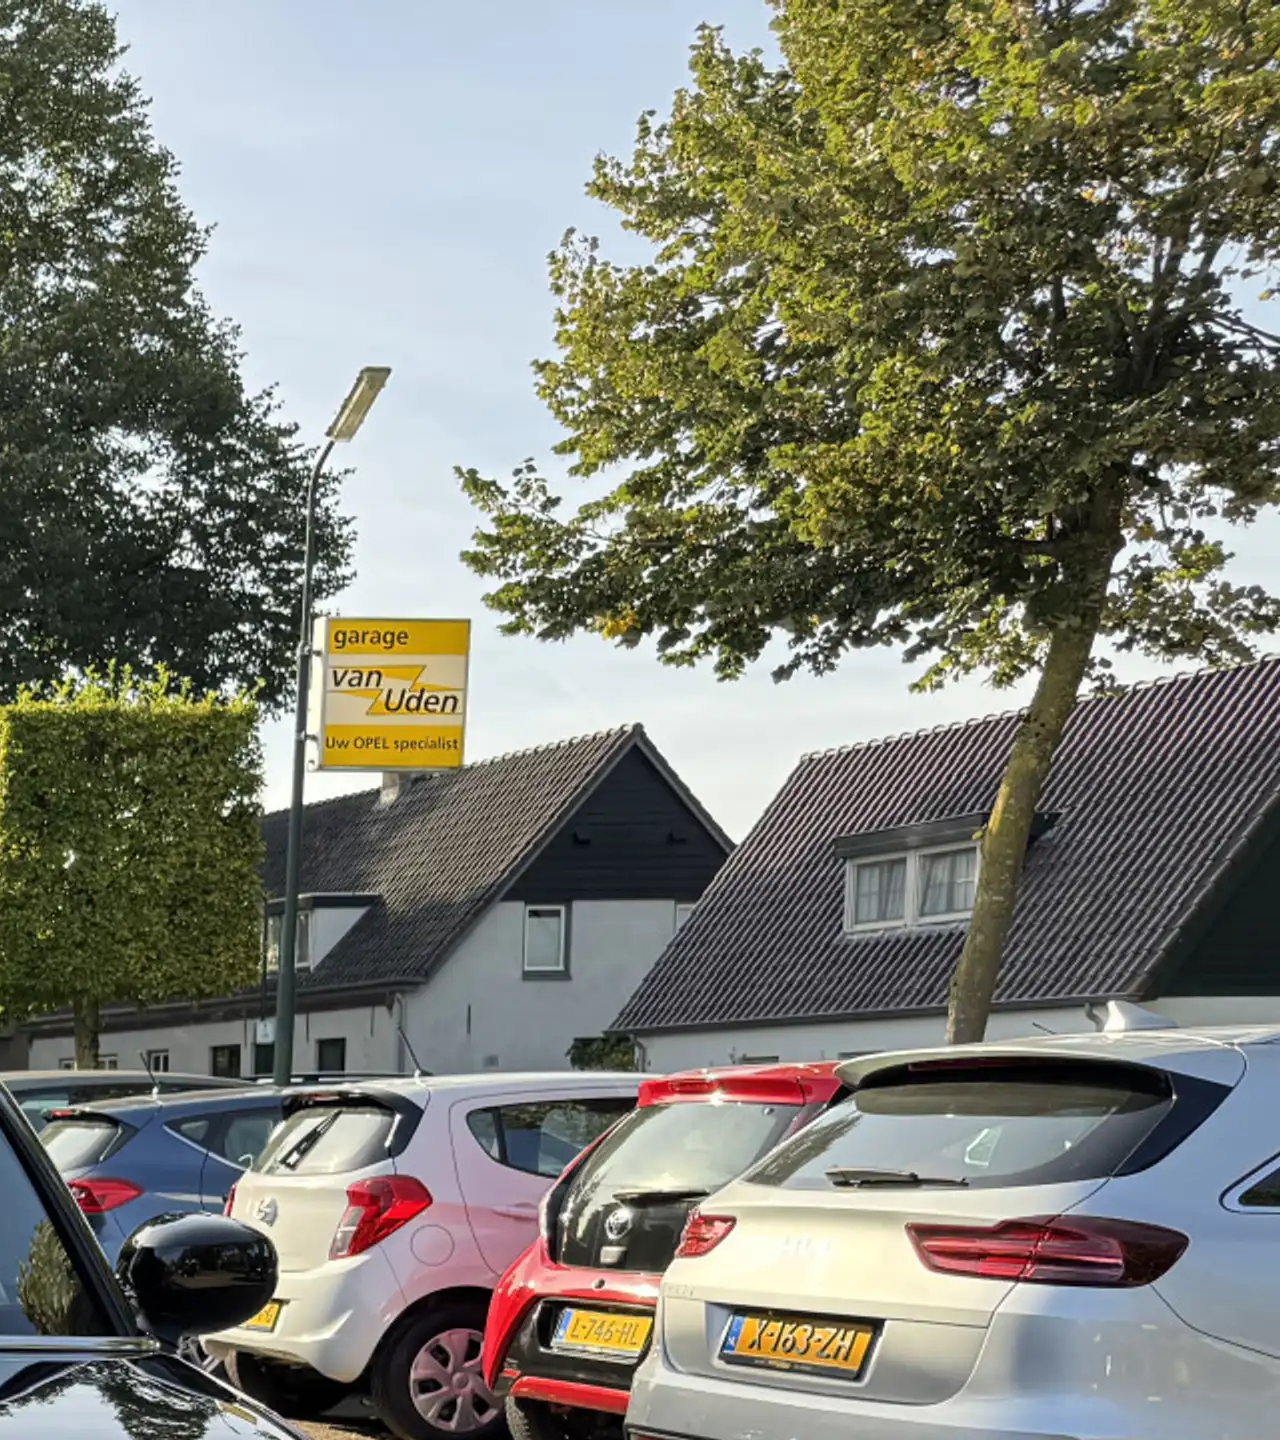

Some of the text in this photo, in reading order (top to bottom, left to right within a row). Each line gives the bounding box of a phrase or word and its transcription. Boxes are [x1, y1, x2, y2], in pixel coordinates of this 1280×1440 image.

[333, 629, 409, 649] garage
[332, 669, 383, 688] van
[384, 688, 459, 714] Uden
[325, 736, 458, 752] Uw OPEL specialist
[570, 1317, 640, 1345] L-746-HL
[748, 1319, 855, 1362] X-163-ZH
